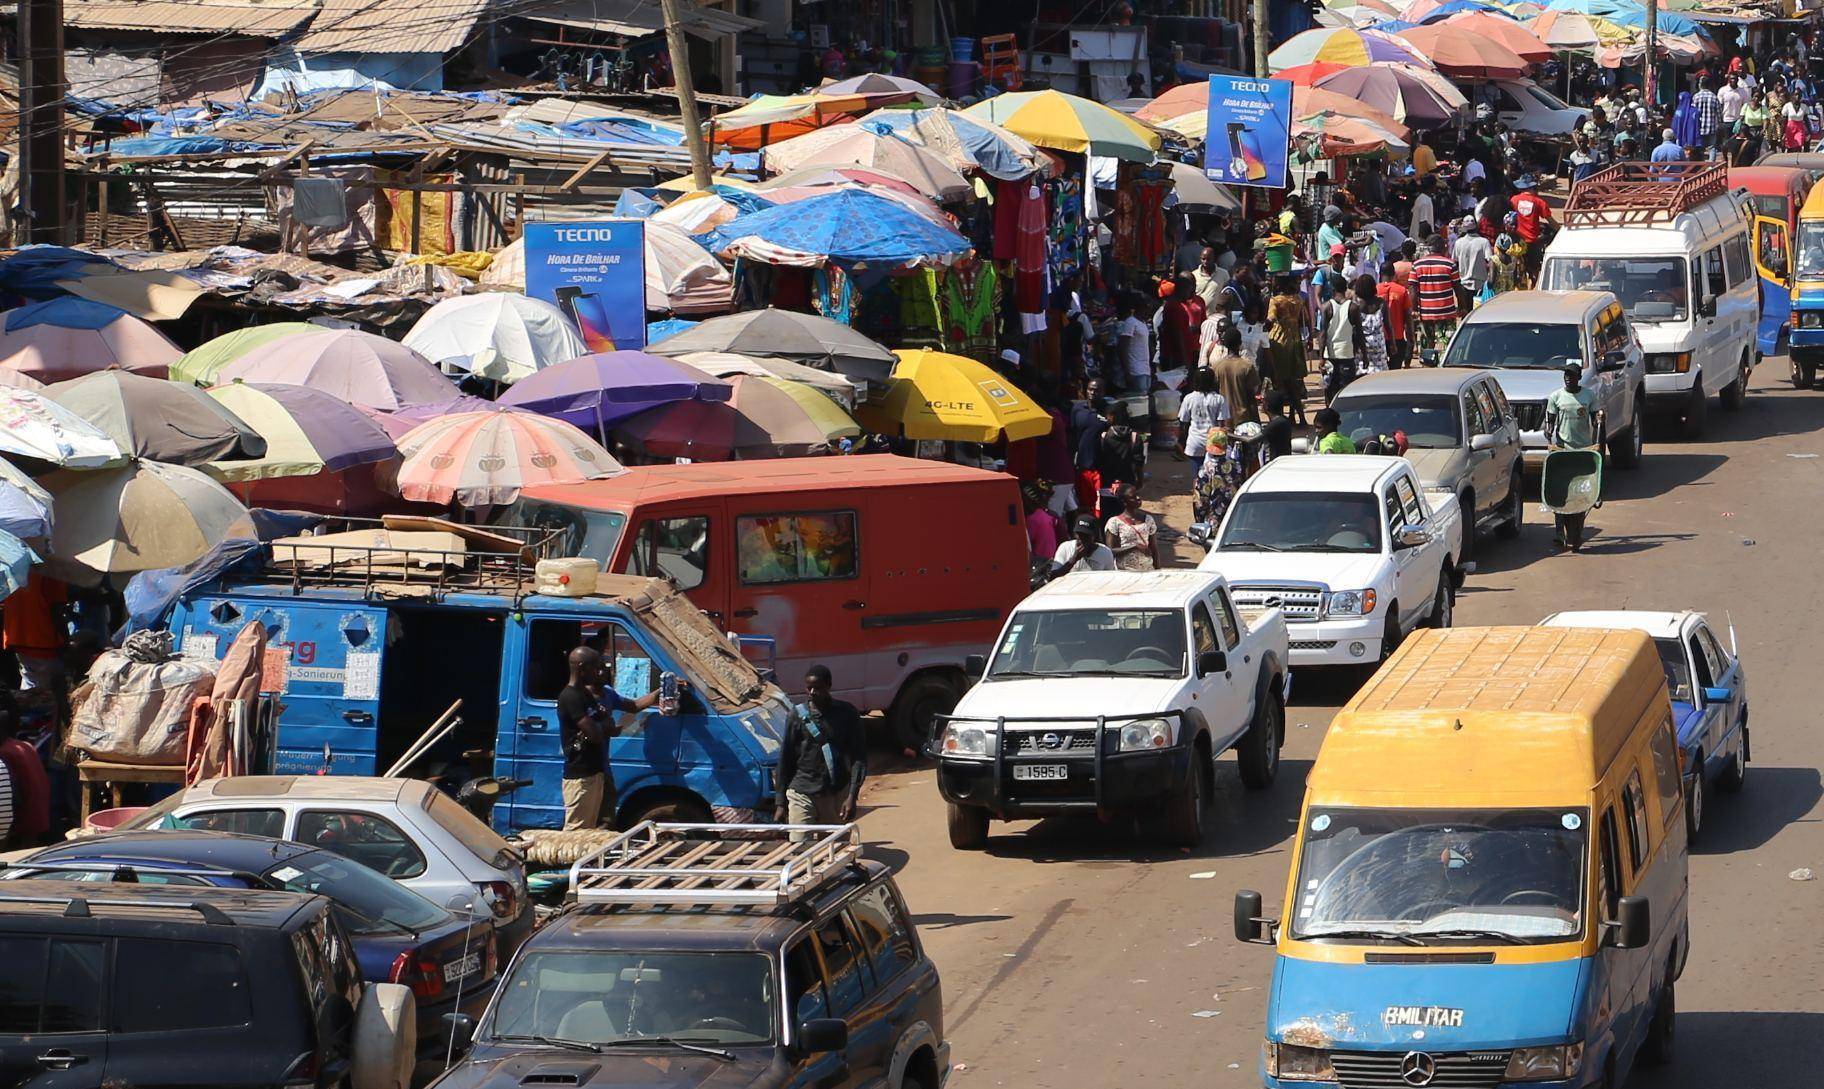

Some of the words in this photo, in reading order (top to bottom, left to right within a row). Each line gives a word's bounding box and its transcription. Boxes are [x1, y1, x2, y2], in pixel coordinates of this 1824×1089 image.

[1230, 81, 1270, 93] TECNO
[554, 228, 612, 243] TECNO
[547, 254, 571, 265] HORA
[572, 254, 584, 265] DE
[924, 400, 974, 411] 4G-LTE
